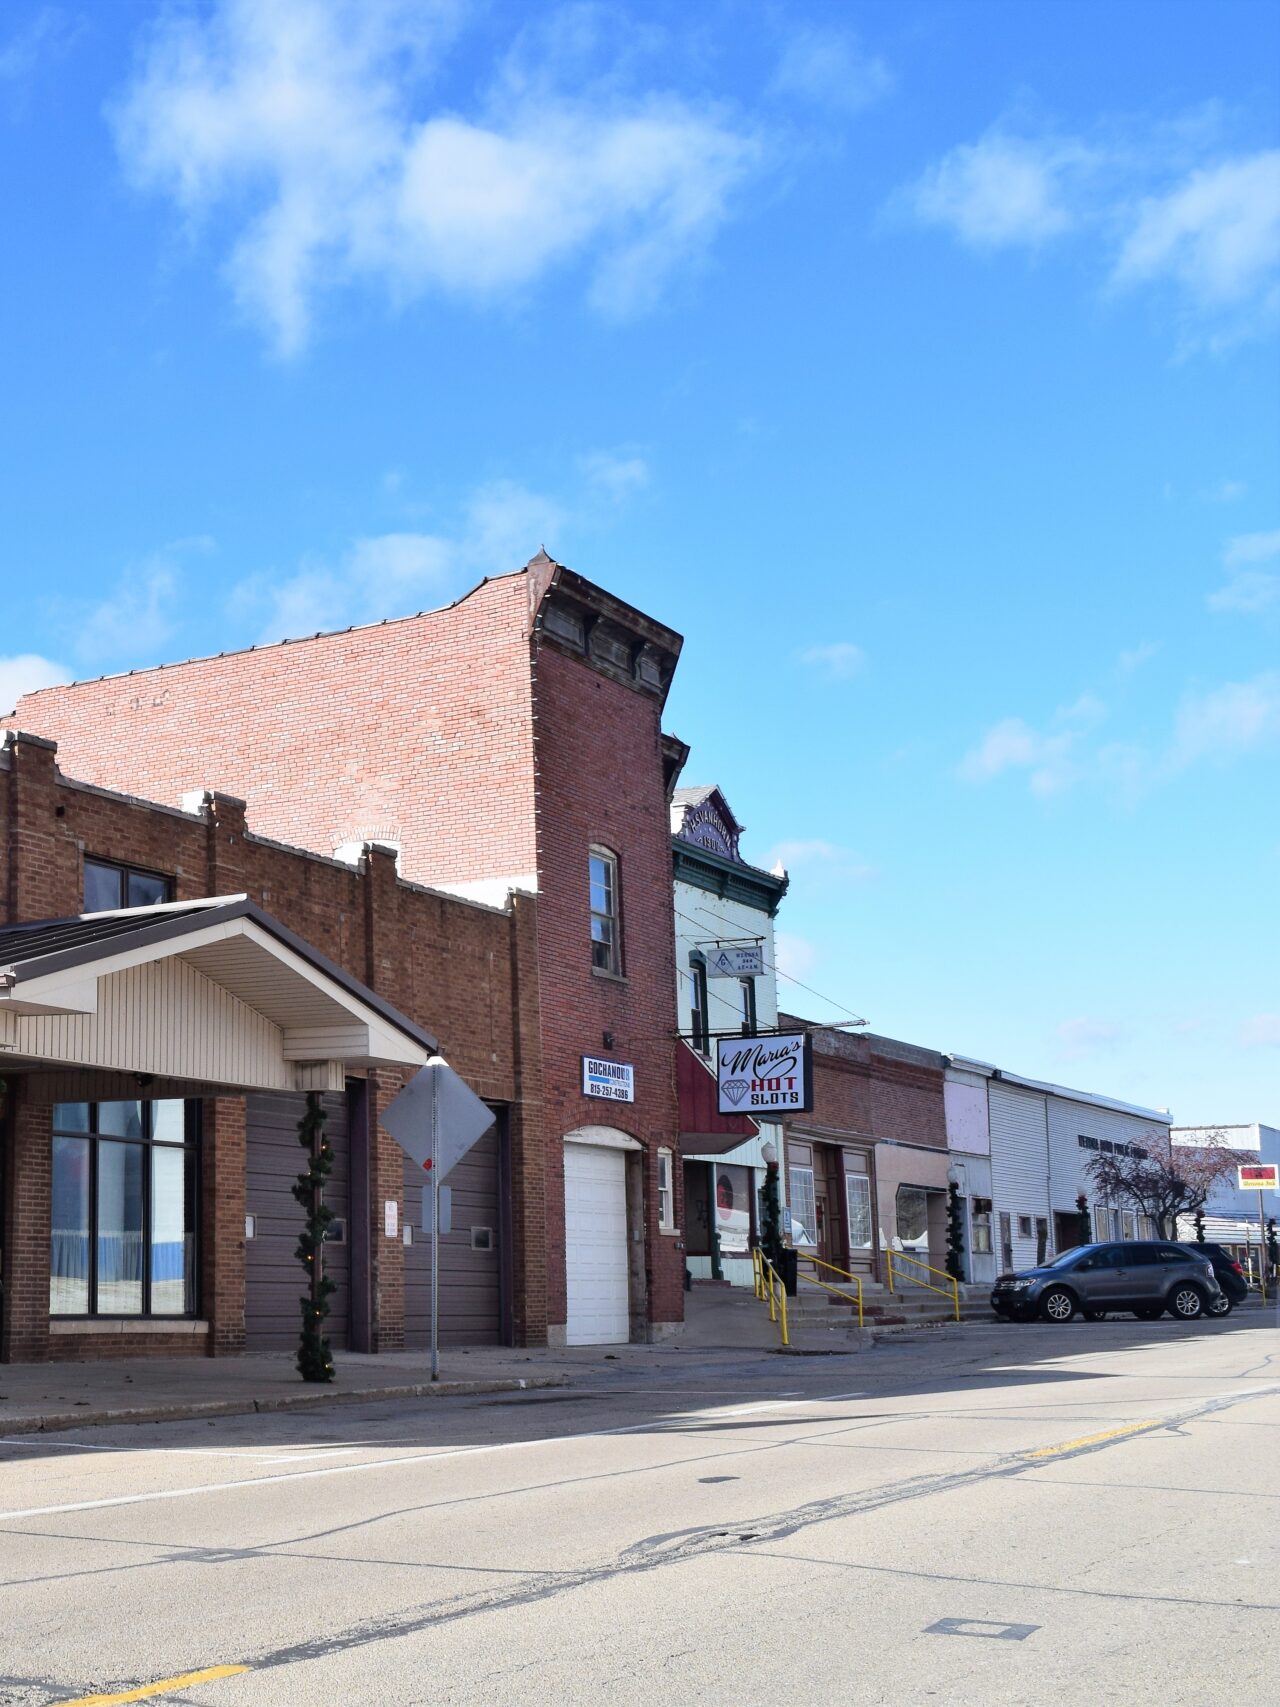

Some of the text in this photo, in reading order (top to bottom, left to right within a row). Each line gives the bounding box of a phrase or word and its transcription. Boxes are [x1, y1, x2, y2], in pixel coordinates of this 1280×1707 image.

[721, 1041, 801, 1080] Maria's
[751, 1076, 797, 1092] HOT
[751, 1091, 799, 1105] SLOTS
